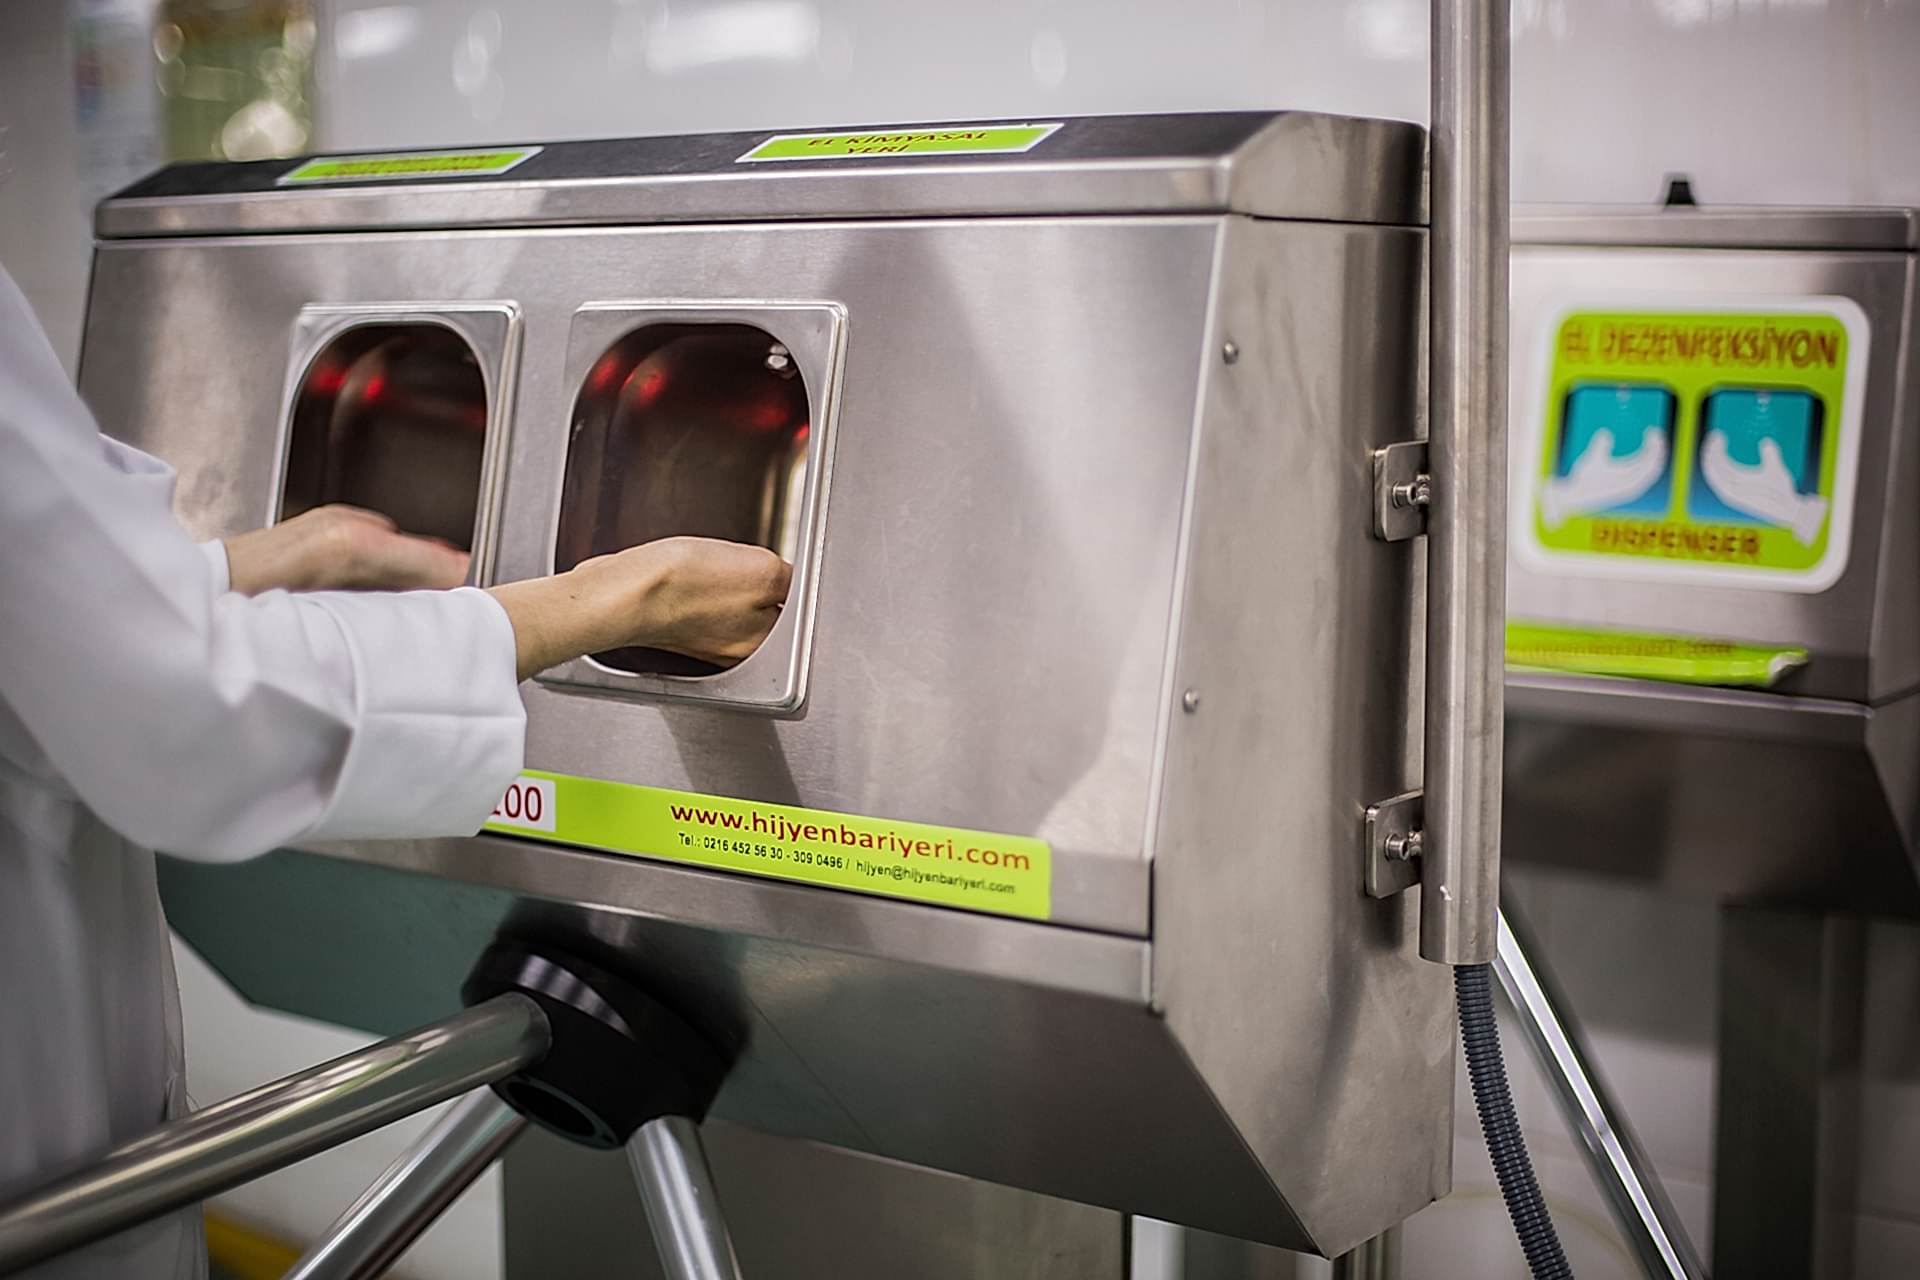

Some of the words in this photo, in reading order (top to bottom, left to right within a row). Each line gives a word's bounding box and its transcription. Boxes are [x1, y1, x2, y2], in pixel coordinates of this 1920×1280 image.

[491, 784, 543, 822] 00
[670, 804, 1031, 871] www.hijyenbariyeri.com
[703, 836, 729, 852] 0216
[731, 841, 751, 855] 452
[754, 844, 767, 857] 56
[770, 847, 783, 860] 30
[793, 850, 813, 864] 309
[816, 854, 843, 869] 0496
[856, 859, 1015, 894] hijyen@hijyenbariyeri.com
